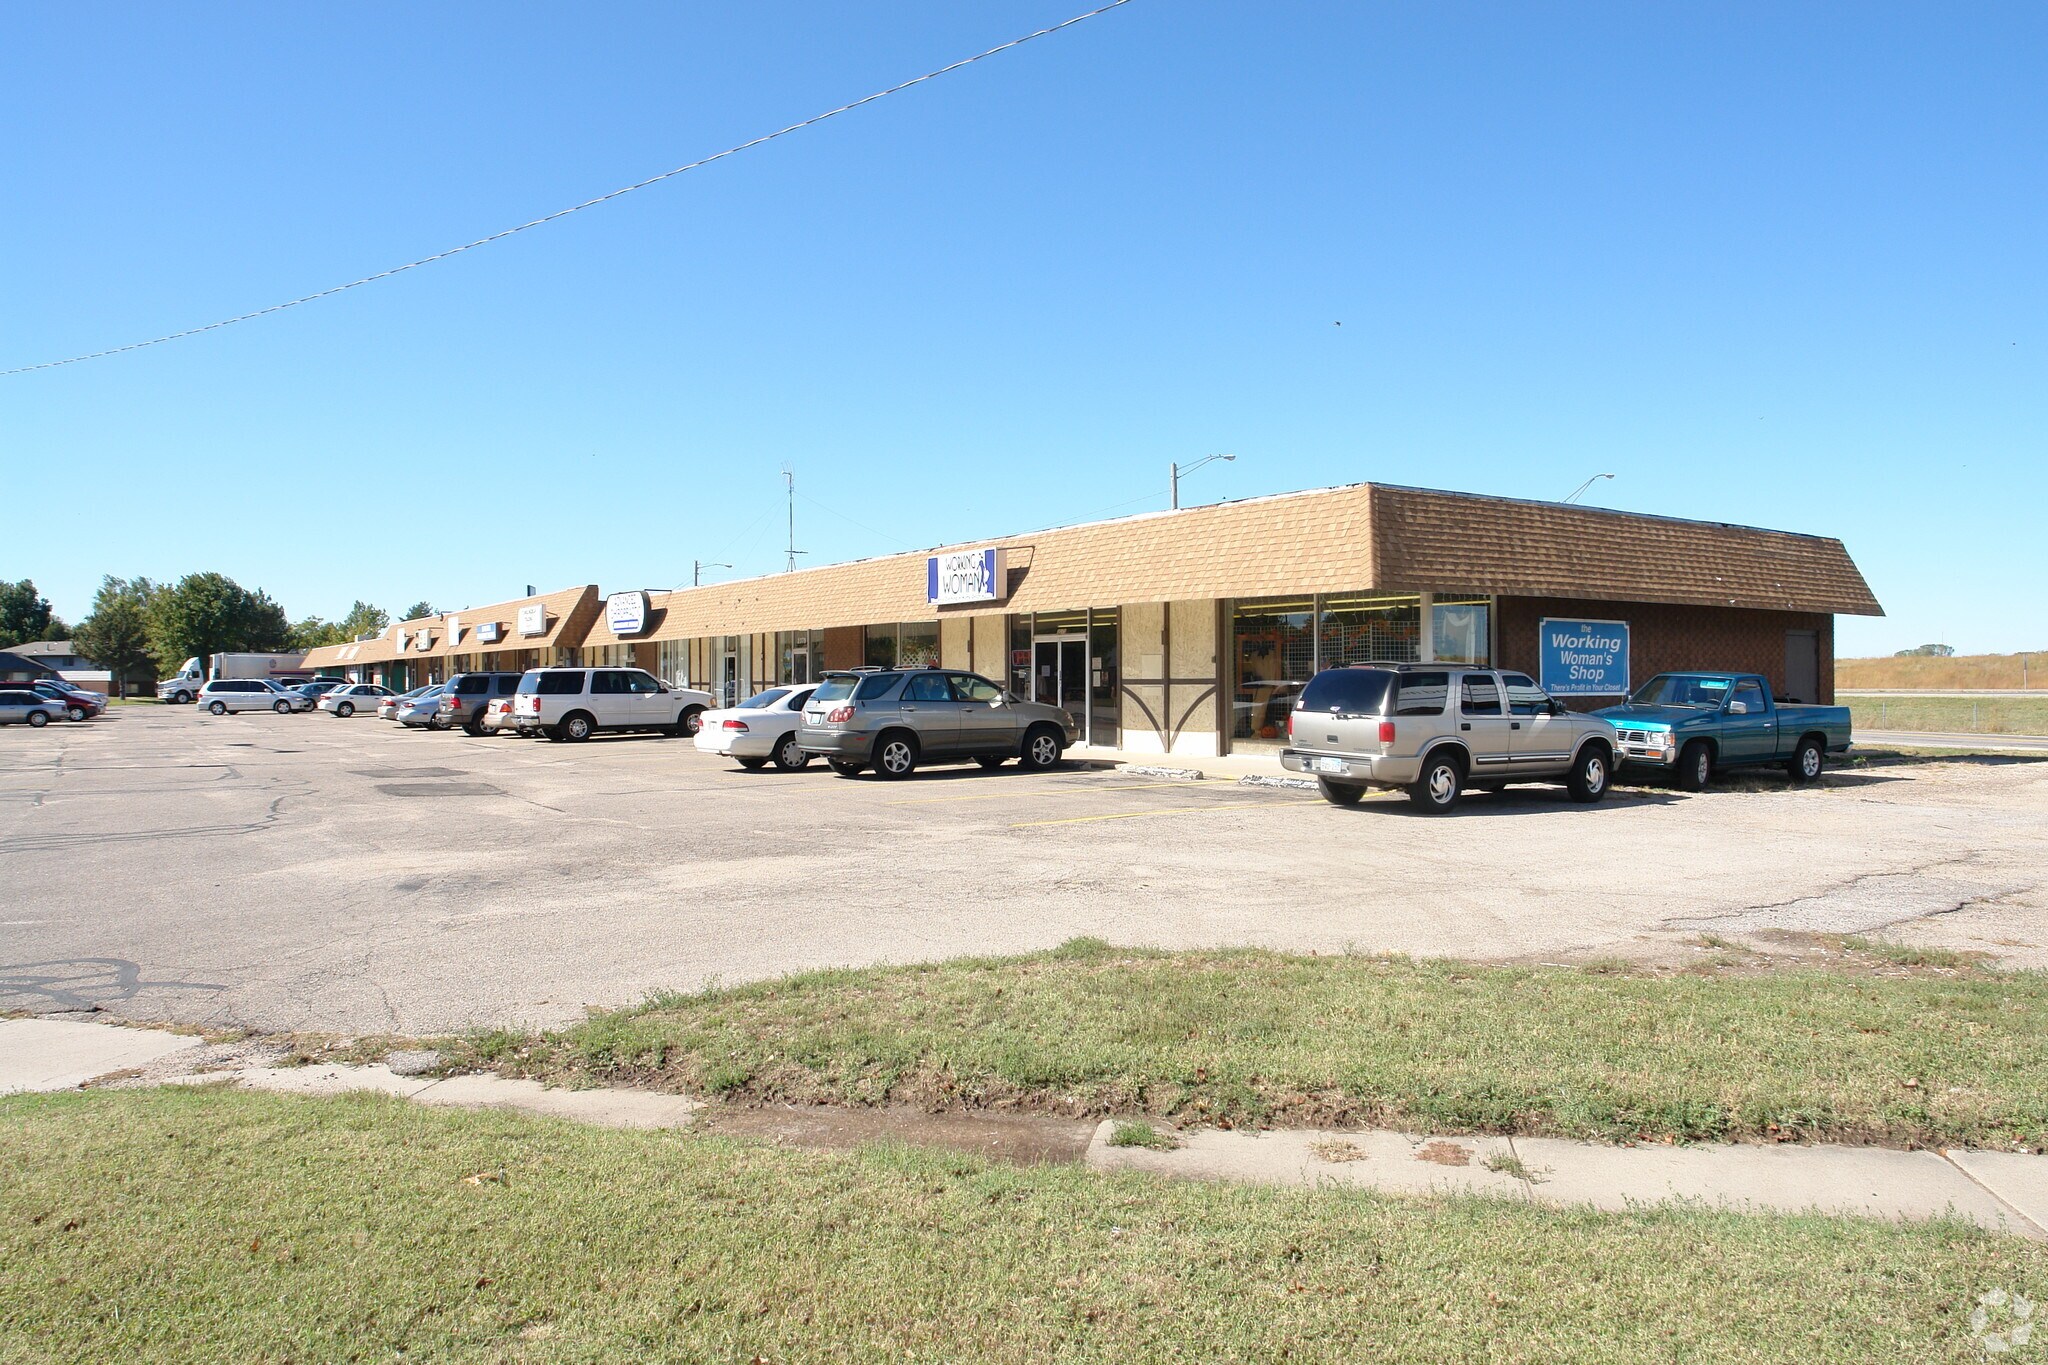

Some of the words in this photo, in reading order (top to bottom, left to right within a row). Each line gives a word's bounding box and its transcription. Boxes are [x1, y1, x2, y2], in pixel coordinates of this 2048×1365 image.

[943, 571, 981, 594] WOMAN
[1551, 633, 1621, 653] Working
[1560, 650, 1613, 666] Woman's
[1569, 665, 1605, 683] Shop
[1550, 683, 1570, 692] There's
[1570, 683, 1585, 691] Profit
[1604, 683, 1621, 691] Closet
